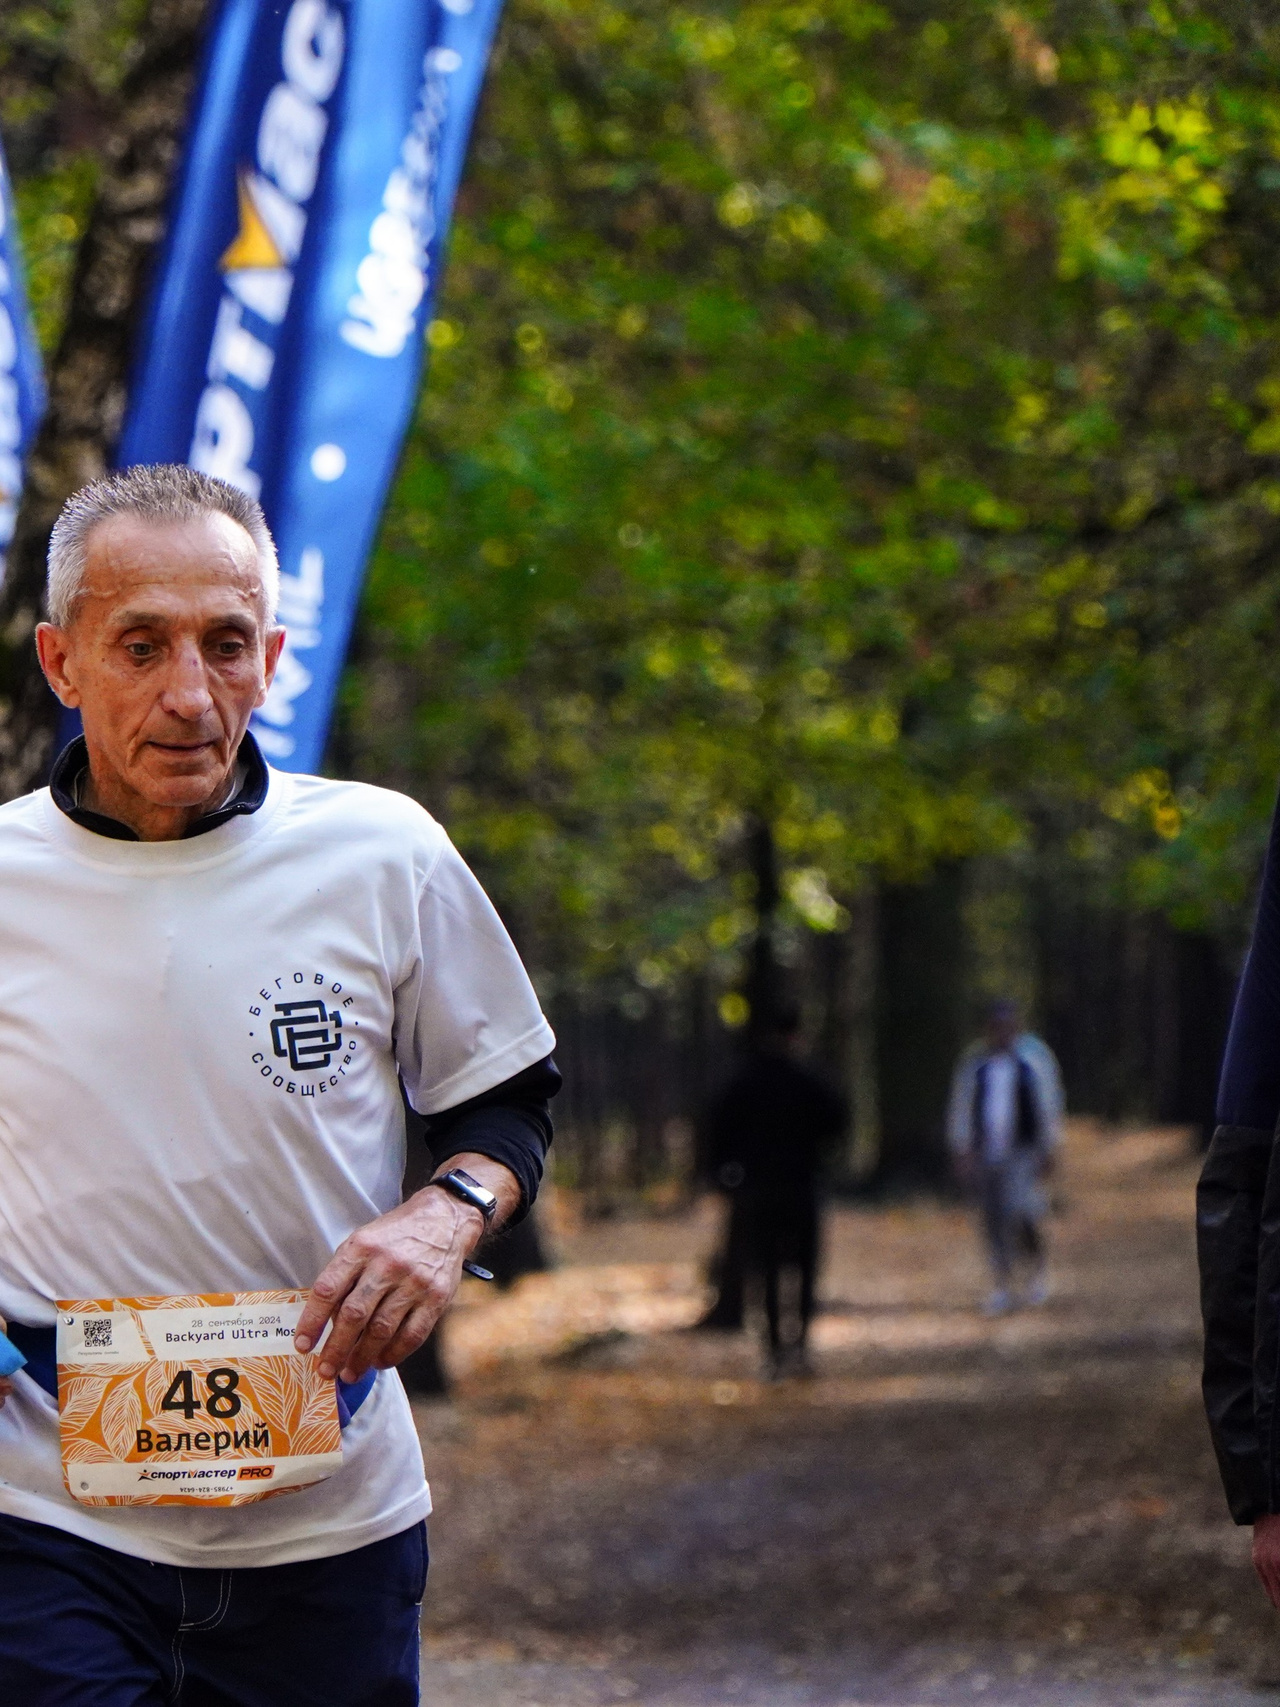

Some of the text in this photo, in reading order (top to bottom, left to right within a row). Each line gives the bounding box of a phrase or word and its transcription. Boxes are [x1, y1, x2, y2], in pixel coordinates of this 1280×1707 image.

[249, 972, 354, 1016] БЕГОВОЕ
[252, 1040, 357, 1098] СООБЩЕСТВО
[165, 1330, 225, 1343] Backyard
[232, 1328, 269, 1340] Ultra
[191, 1316, 282, 1328] 28 сентября 2024
[161, 1367, 242, 1420] 48
[136, 1422, 270, 1456] Валерий
[239, 1467, 273, 1478] PRO
